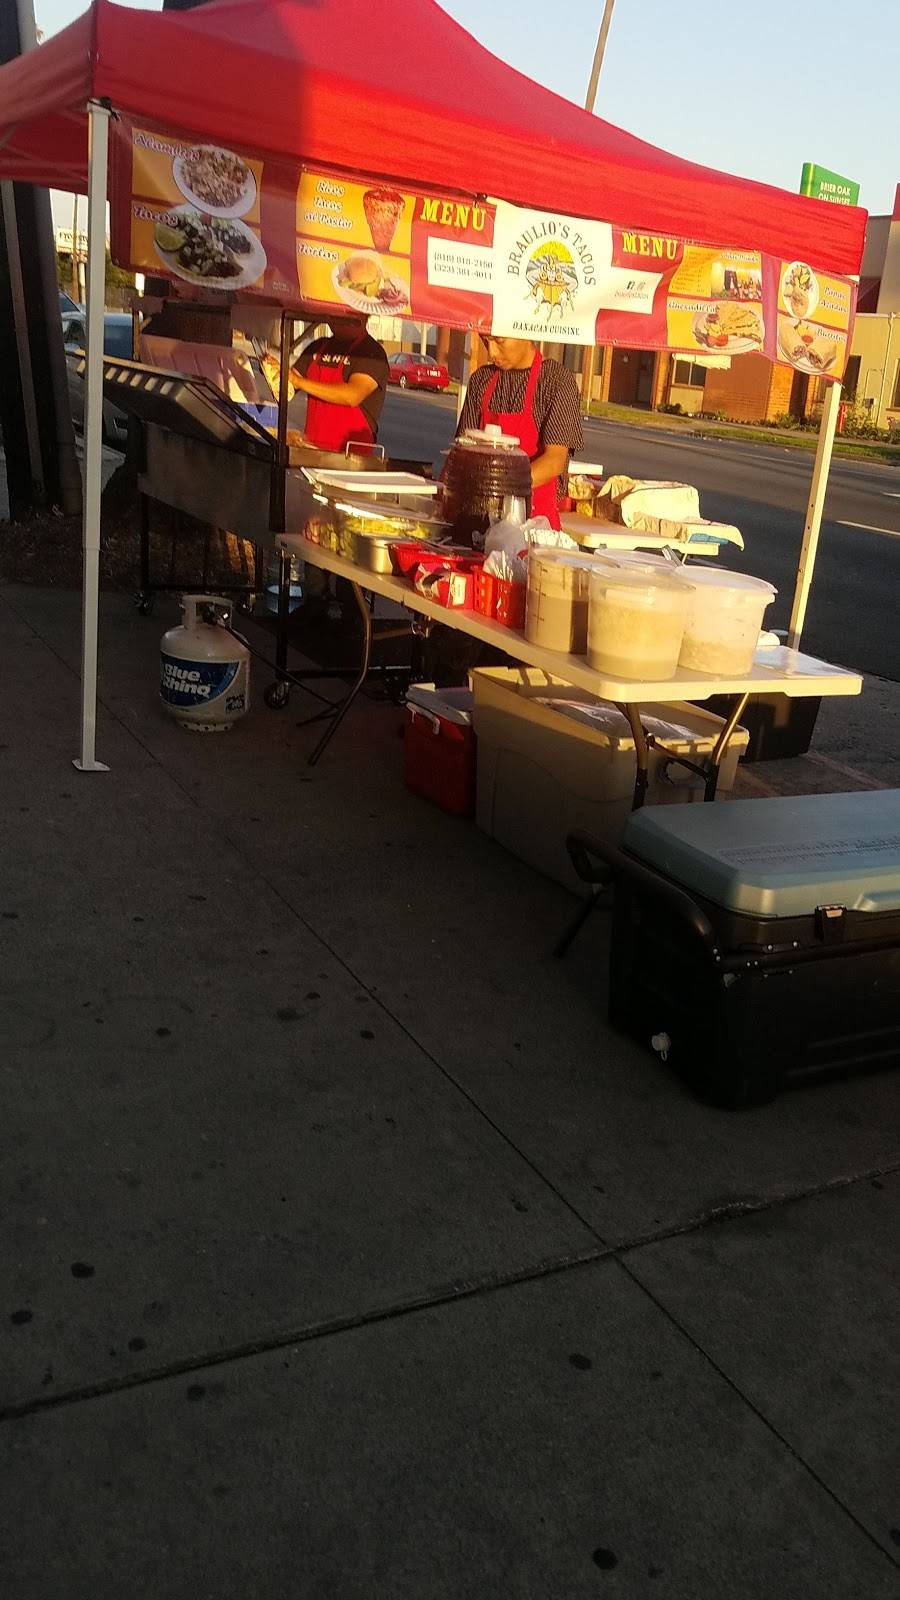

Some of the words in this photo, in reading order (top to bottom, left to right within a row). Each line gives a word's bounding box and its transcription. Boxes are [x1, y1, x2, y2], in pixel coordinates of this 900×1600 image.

[818, 193, 829, 202] ON
[820, 181, 836, 193] BRIER
[837, 185, 851, 196] OAK
[132, 204, 179, 227] Tacos
[420, 198, 487, 231] MENU
[297, 243, 339, 261] Tortas
[507, 220, 571, 276] BRAULIO'S
[571, 232, 597, 286] TACOS
[621, 231, 678, 260] MENU
[513, 321, 548, 333] OAXACAN
[549, 325, 580, 336] CUISINE
[164, 663, 201, 682] Blue
